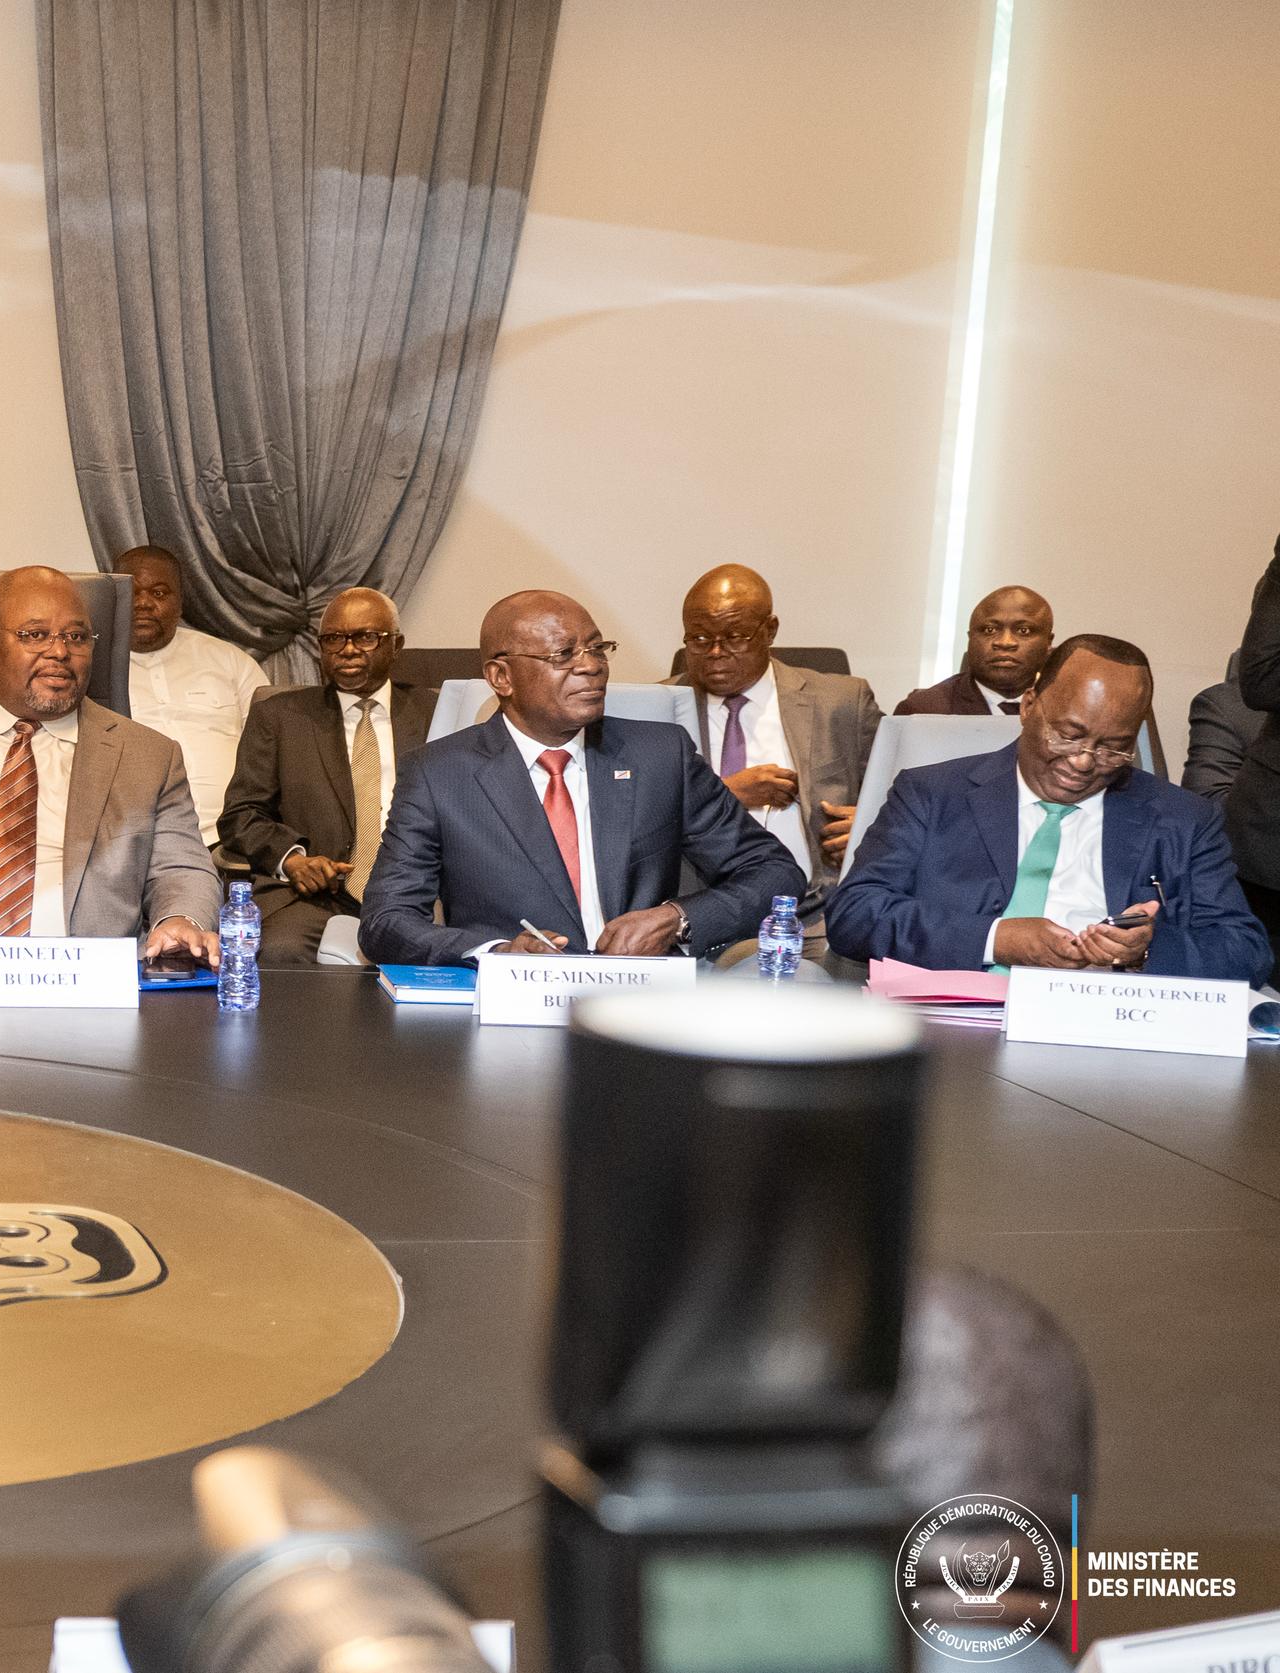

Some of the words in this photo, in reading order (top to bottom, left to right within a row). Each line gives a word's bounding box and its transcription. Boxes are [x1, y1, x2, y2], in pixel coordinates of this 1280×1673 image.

[0, 947, 85, 961] MINETAT
[5, 973, 81, 986] BUDGET
[510, 969, 651, 985] VICE-MINISTRE
[1069, 983, 1107, 995] VICE
[1112, 986, 1227, 1004] GOUVERNEUR
[1115, 1007, 1157, 1023] BCC
